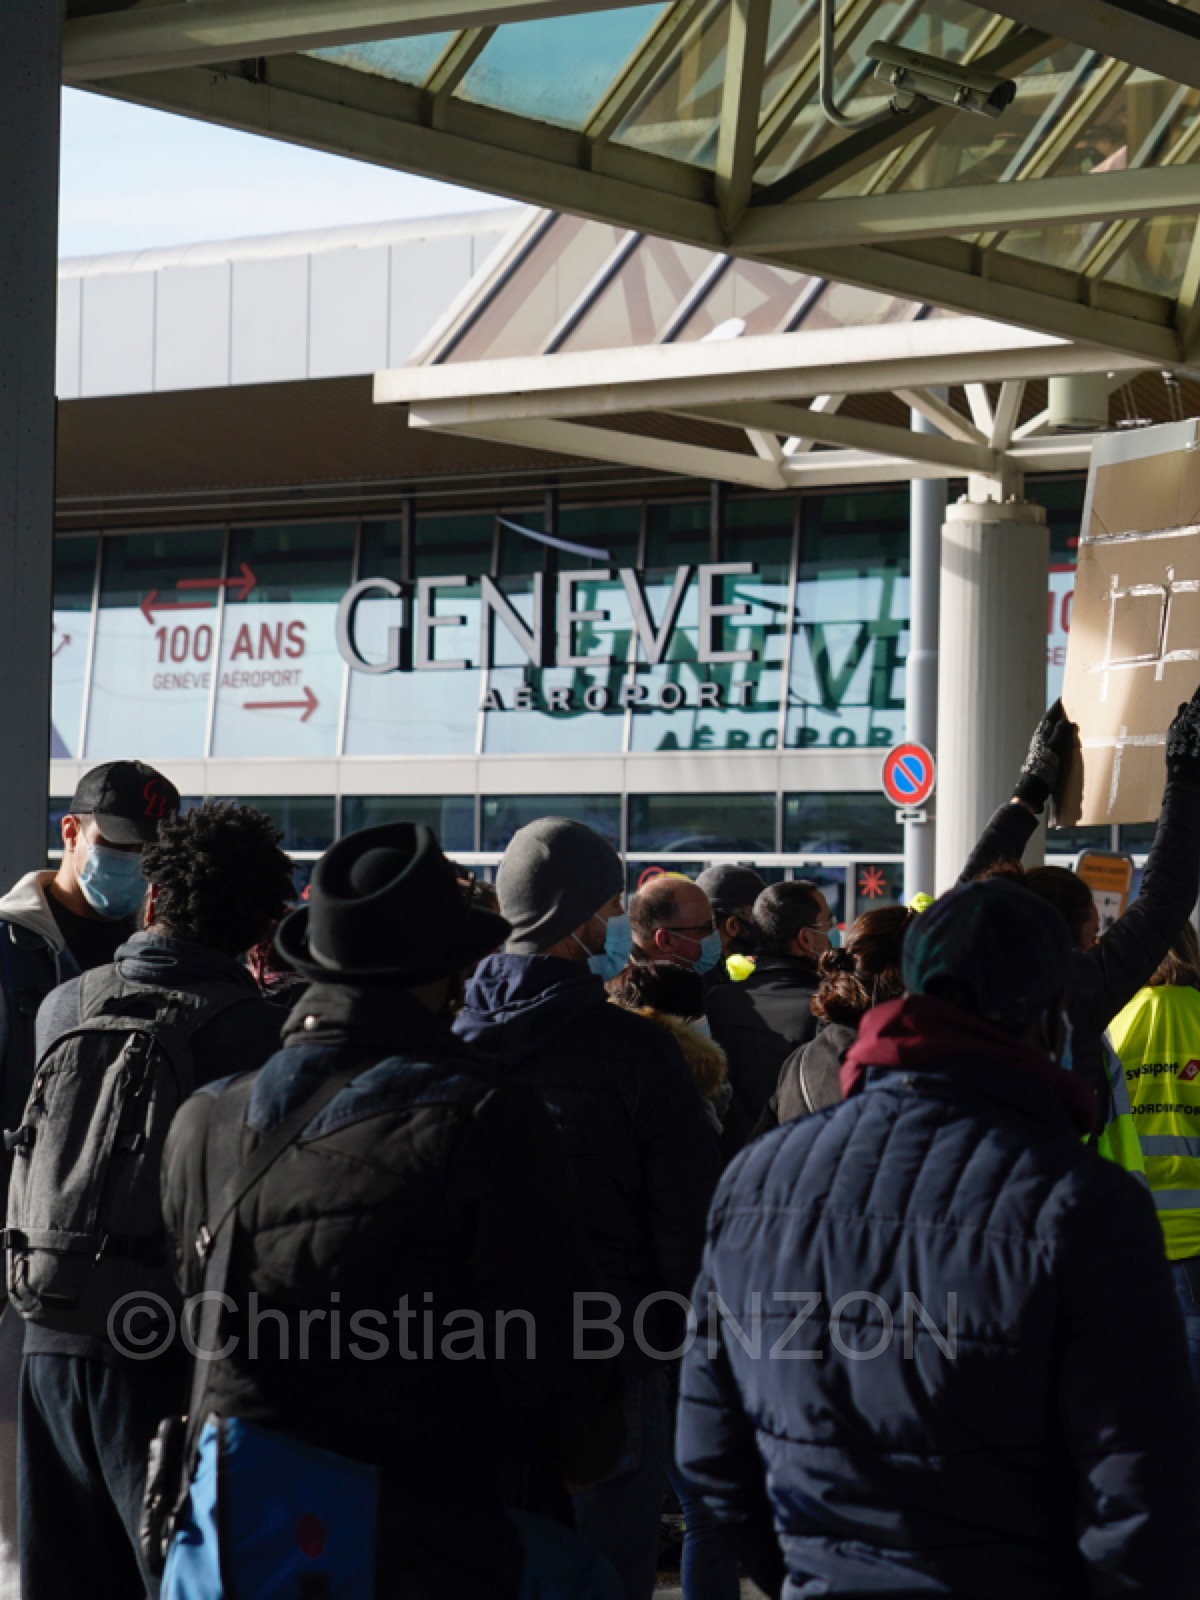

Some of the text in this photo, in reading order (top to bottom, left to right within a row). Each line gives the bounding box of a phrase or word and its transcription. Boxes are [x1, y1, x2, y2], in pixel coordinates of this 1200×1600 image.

[155, 619, 306, 663] 100 ANS
[220, 668, 302, 688] AÉROPORT
[477, 680, 757, 712] AÉROPORT
